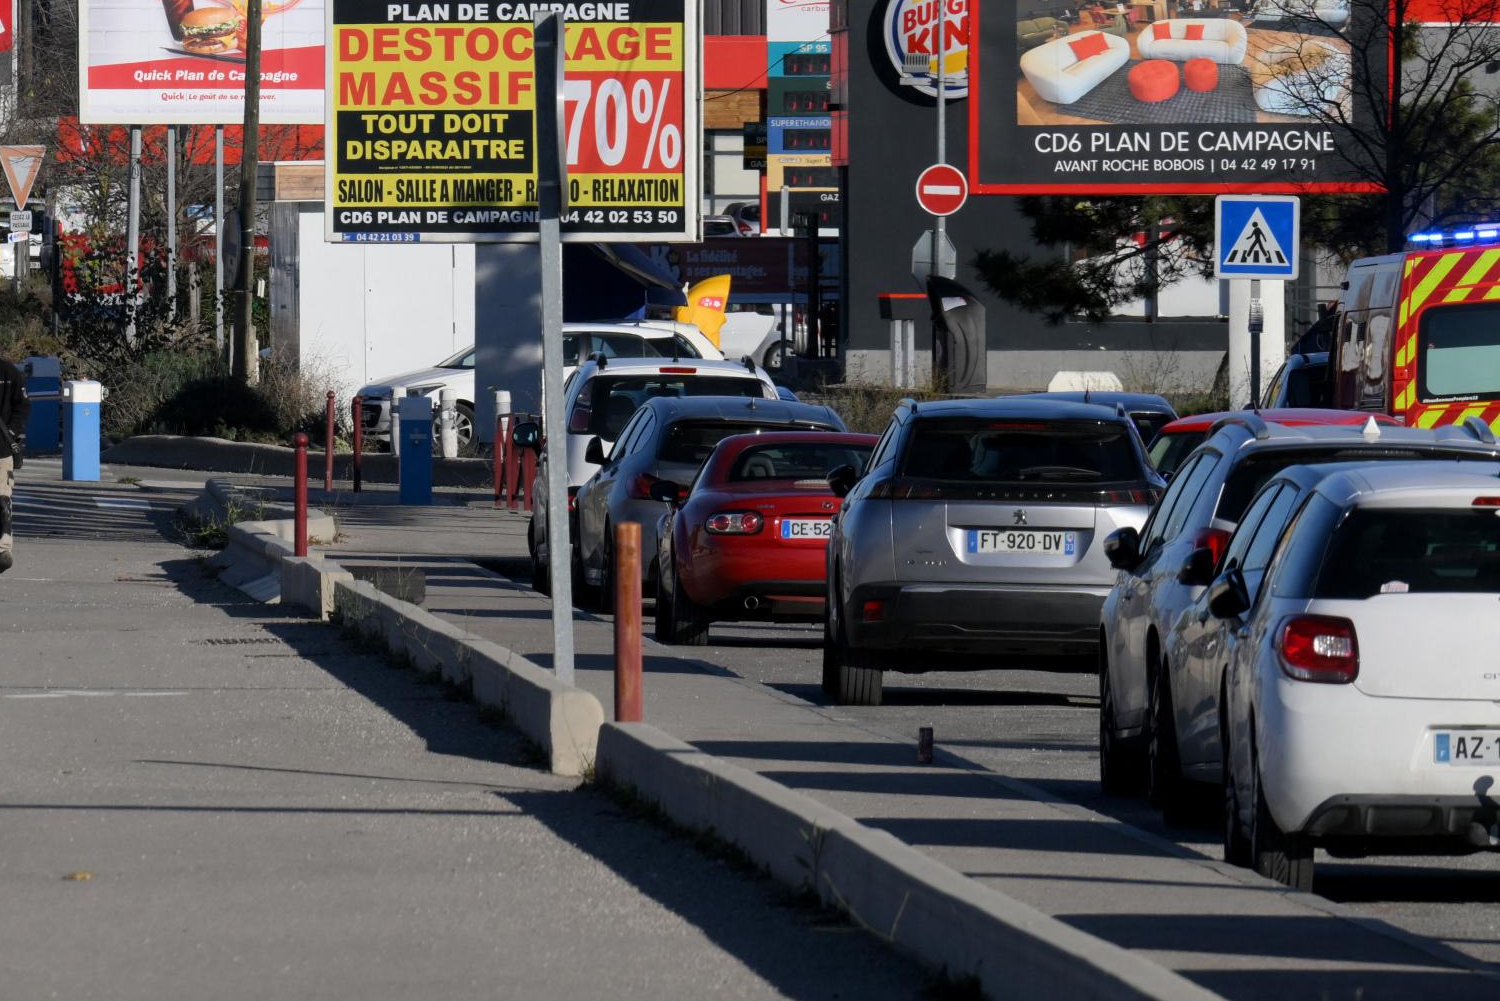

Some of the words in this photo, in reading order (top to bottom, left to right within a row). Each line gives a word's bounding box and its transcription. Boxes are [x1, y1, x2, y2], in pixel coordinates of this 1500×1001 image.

[388, 4, 450, 21] PLAN
[457, 4, 489, 21] DE
[907, 15, 969, 55] KIN
[339, 27, 673, 62] DESTOCAGE
[815, 44, 828, 53] 95
[134, 70, 171, 81] Quick
[175, 69, 204, 81] Plan
[208, 69, 225, 81] de
[229, 70, 298, 83] Capagne
[161, 91, 185, 101] Quick
[199, 92, 216, 102] goût
[218, 92, 228, 101] de
[339, 71, 534, 106] MASSIF
[361, 114, 436, 134] TOUT
[444, 113, 509, 134] DOIT
[346, 139, 525, 160] DISPARAITRE
[1034, 132, 1082, 153] CD6
[1091, 131, 1151, 152] PLAN
[1160, 131, 1189, 152] DE
[1198, 130, 1335, 152] CAMPAGNE
[1054, 159, 1098, 172] AVANT
[1102, 159, 1149, 172] ROCHE
[1154, 159, 1205, 172] BOBOIS
[1221, 159, 1236, 171] 04
[1241, 159, 1257, 171] 42
[1261, 158, 1276, 171] 49
[1282, 158, 1296, 171] 17
[1300, 158, 1316, 171] 91
[338, 179, 384, 204] SALON
[396, 179, 438, 203] SALLE
[440, 179, 449, 203] A
[453, 179, 513, 203] MANGER
[592, 178, 679, 203] RELAXATION
[820, 193, 840, 201] GAZ
[340, 211, 373, 224] CD6
[377, 211, 423, 224] PLAN
[426, 211, 449, 224] DE
[584, 211, 605, 224] 42
[609, 211, 629, 224] 02
[633, 211, 653, 224] 53
[657, 211, 678, 224] 50
[356, 233, 367, 241] 04
[368, 233, 379, 241] 42
[380, 233, 390, 241] 21
[392, 233, 403, 241] 03
[404, 233, 415, 241] 39
[791, 522, 831, 536] CE-52
[980, 532, 1062, 551] FT-920-DV
